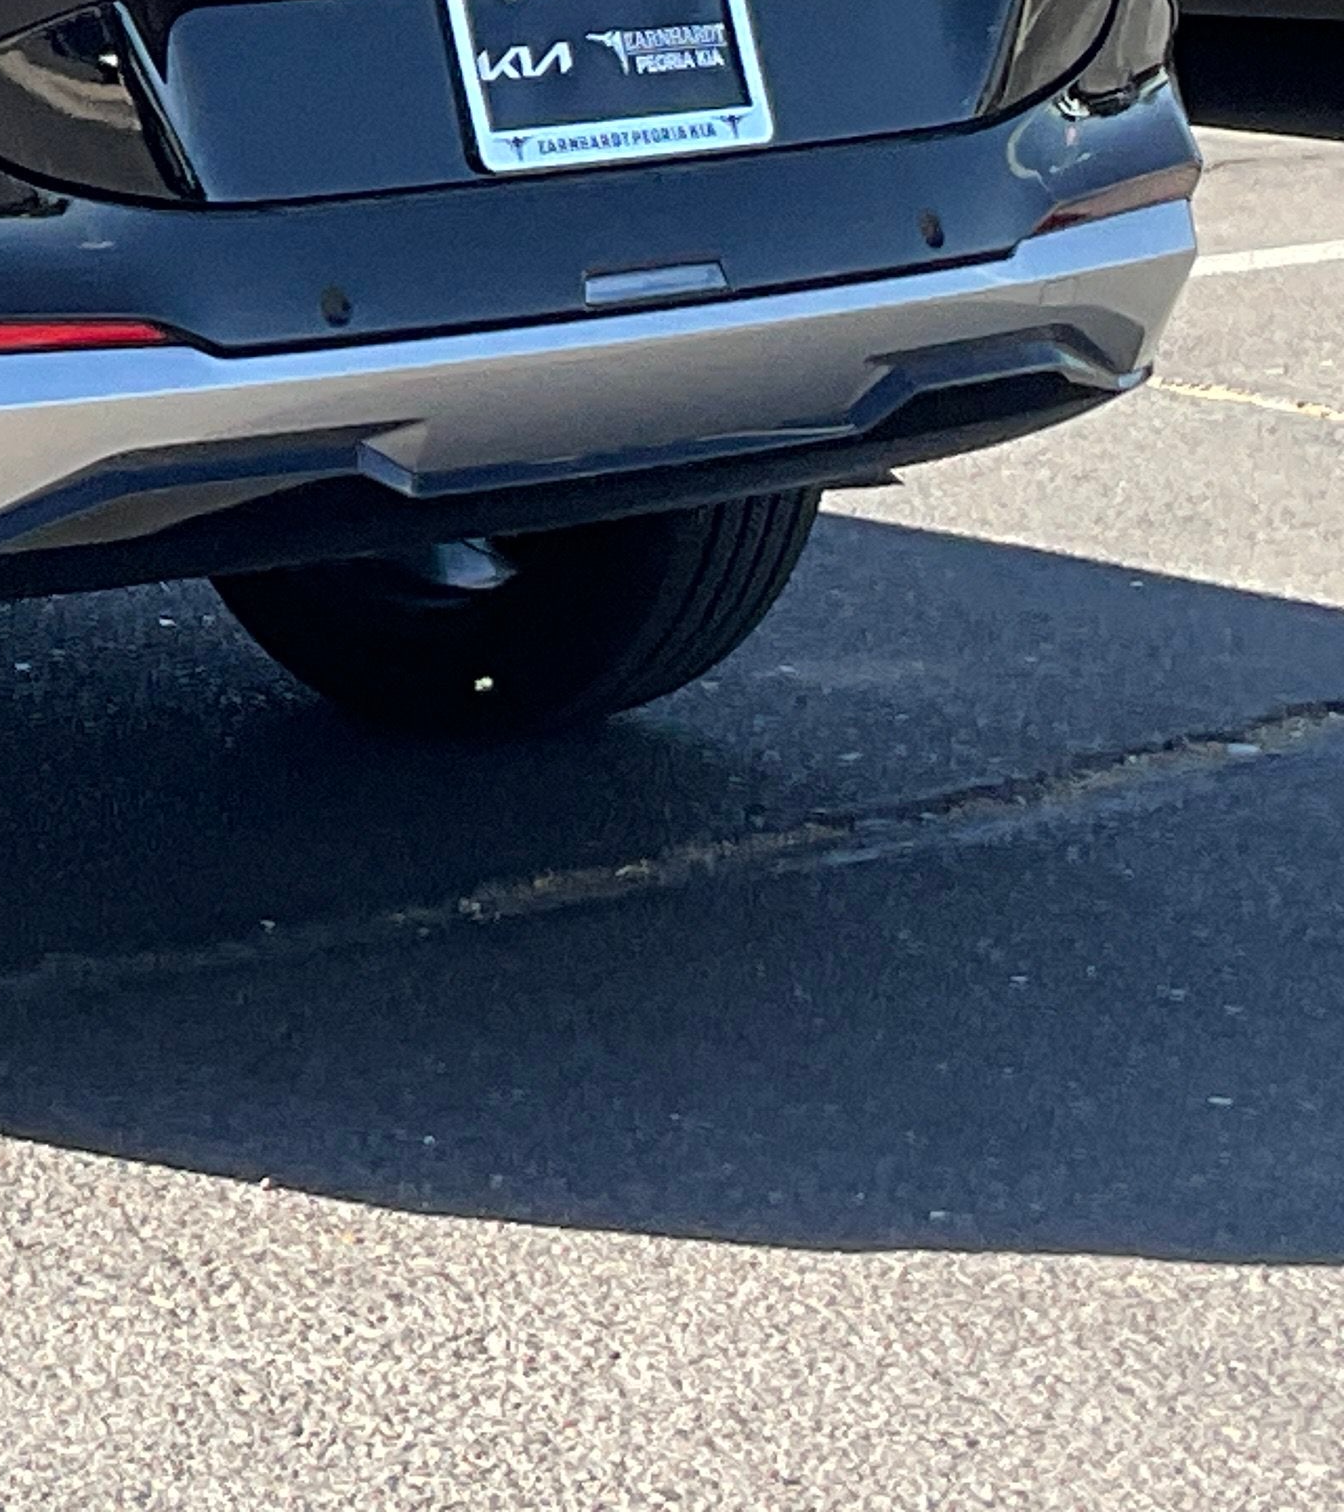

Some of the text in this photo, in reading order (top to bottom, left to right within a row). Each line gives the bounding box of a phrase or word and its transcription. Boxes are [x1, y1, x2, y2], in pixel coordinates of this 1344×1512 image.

[477, 41, 573, 81] KIA
[635, 48, 724, 74] PEORIA KIA
